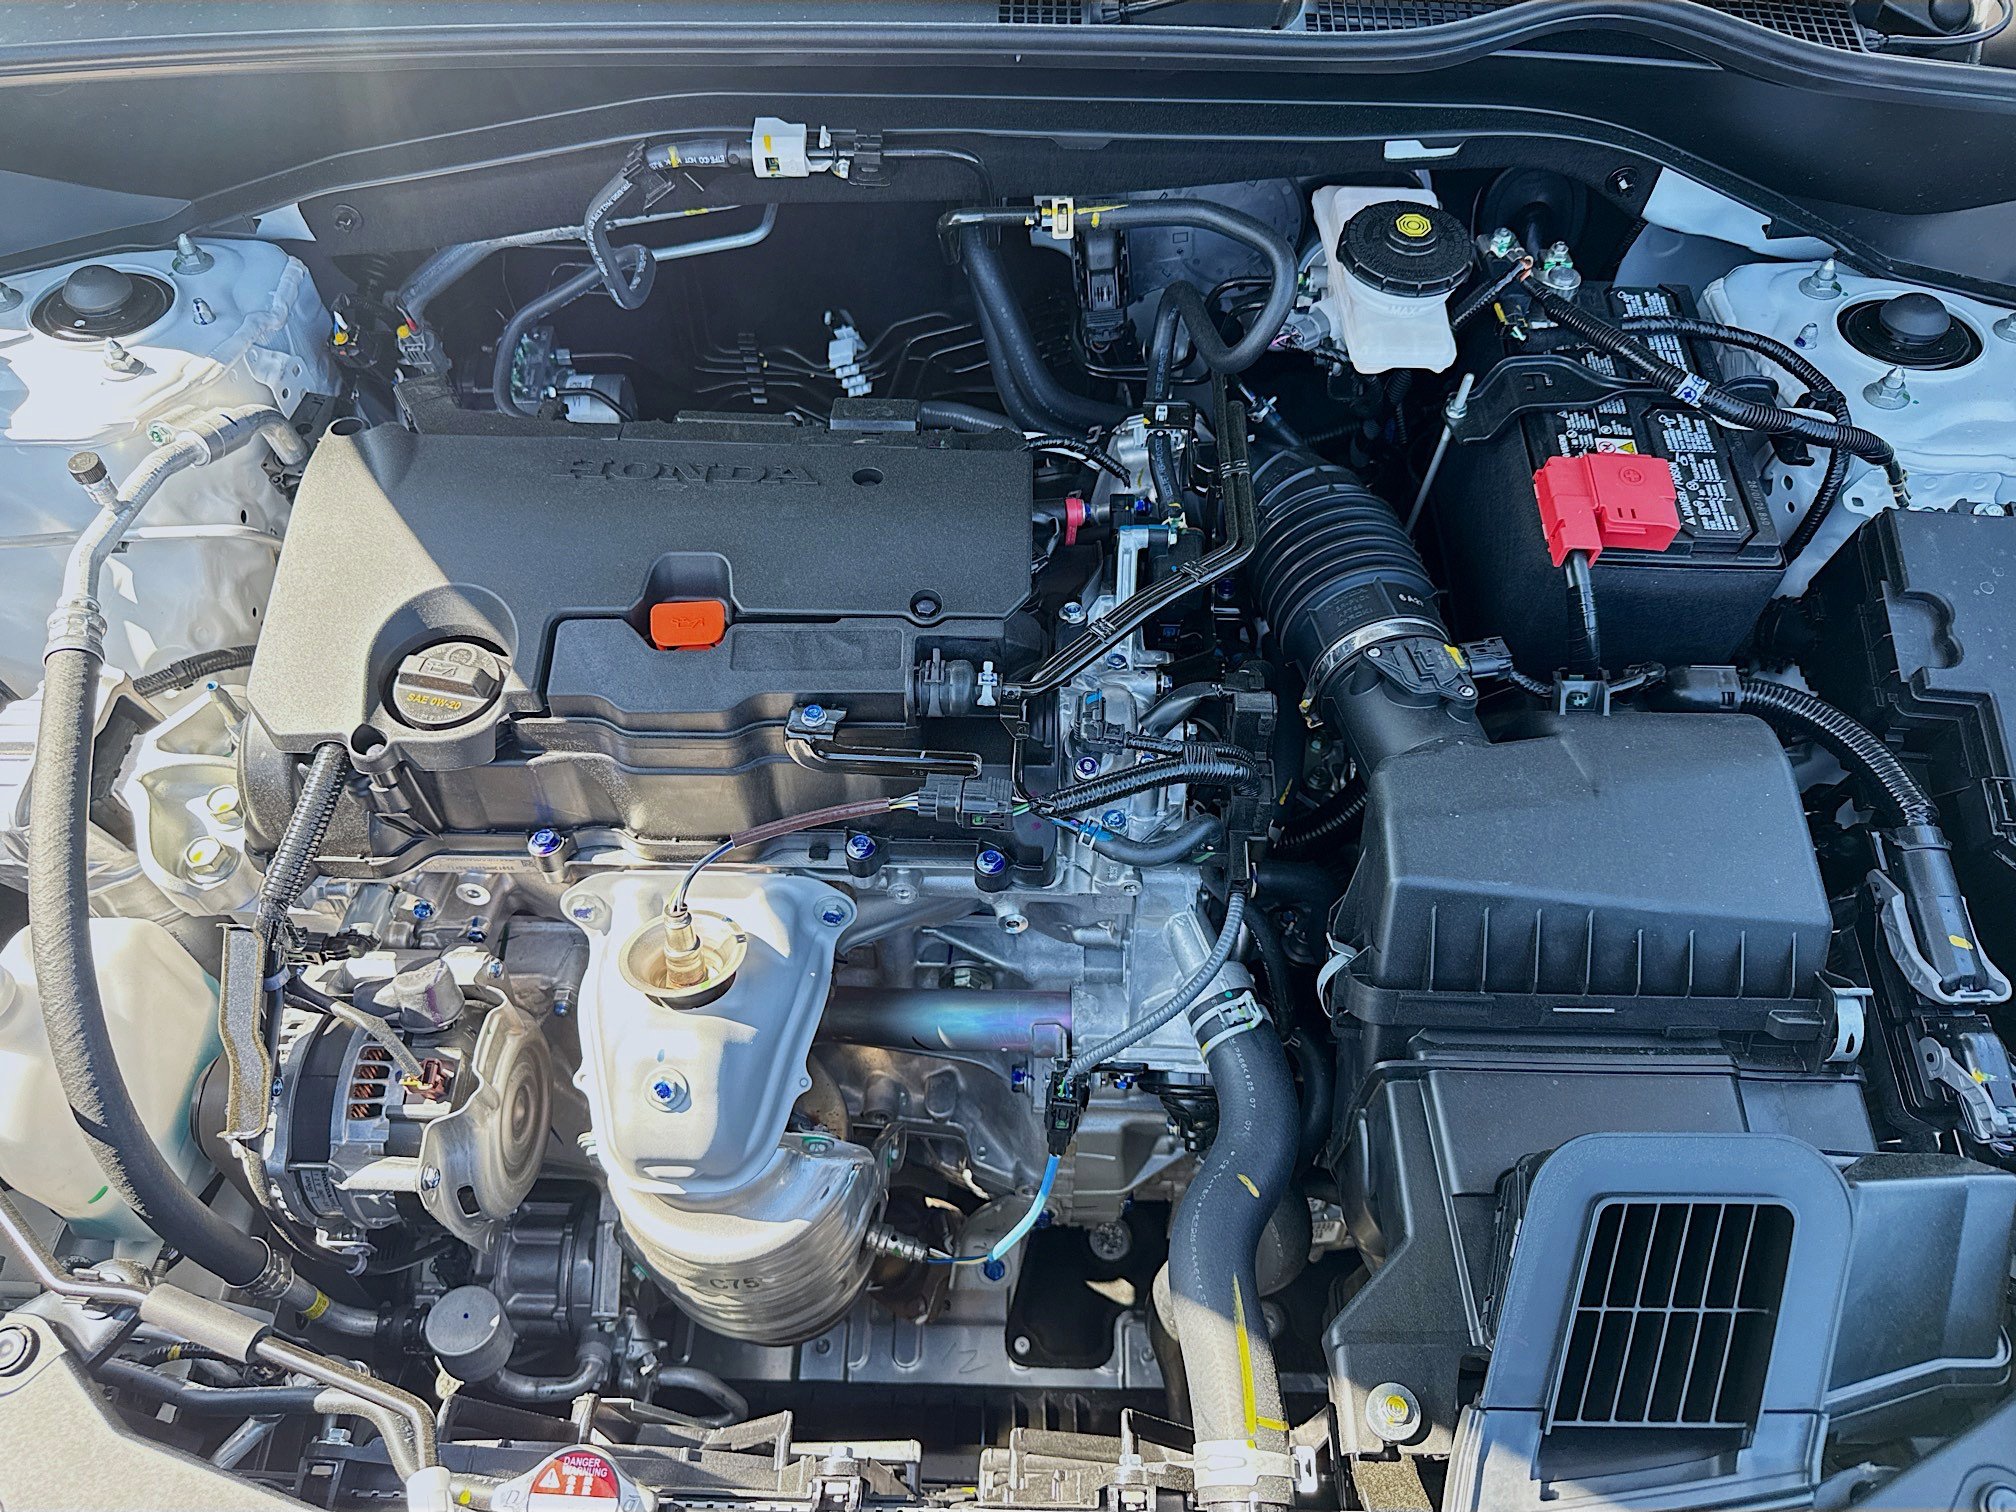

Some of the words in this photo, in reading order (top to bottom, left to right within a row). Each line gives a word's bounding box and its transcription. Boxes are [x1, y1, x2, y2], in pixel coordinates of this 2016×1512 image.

[551, 457, 820, 486] HONDA
[406, 692, 429, 704] SAE
[430, 696, 461, 709] 0W-20
[709, 1276, 761, 1291] C75
[563, 1456, 601, 1468] DANGER
